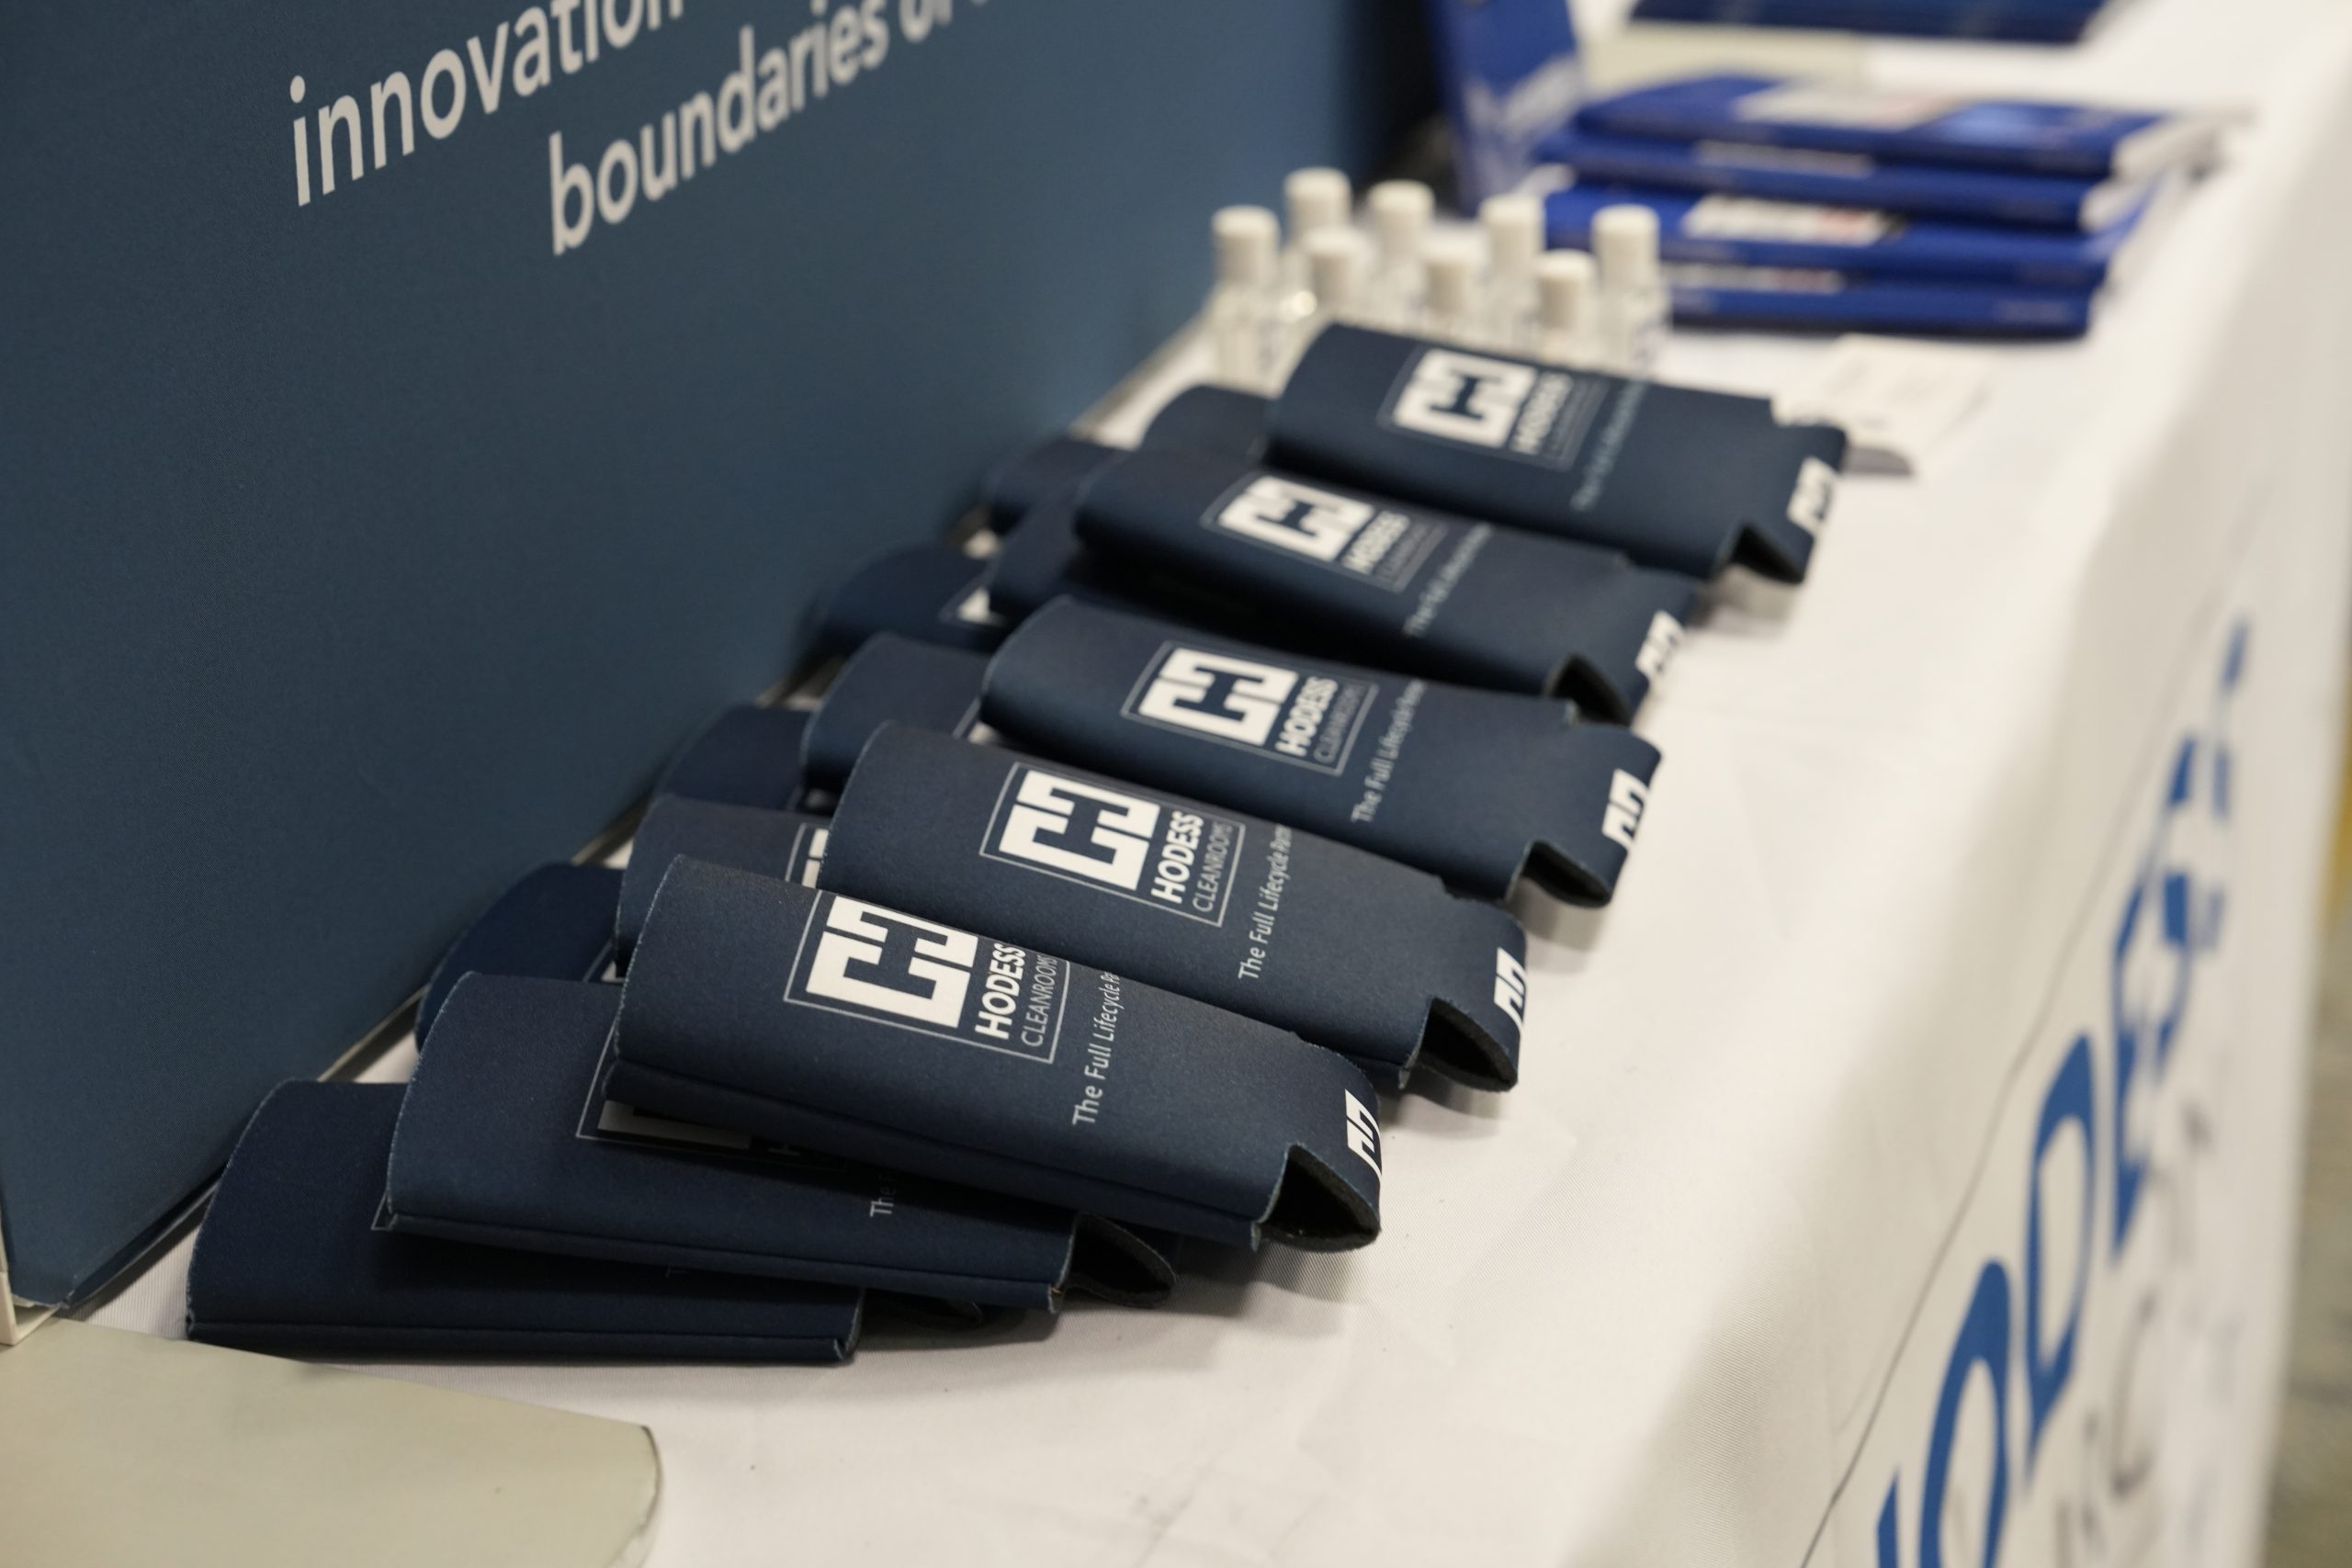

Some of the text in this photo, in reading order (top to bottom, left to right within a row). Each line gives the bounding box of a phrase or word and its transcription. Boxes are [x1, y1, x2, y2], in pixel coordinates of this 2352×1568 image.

[550, 0, 890, 255] boundaries
[1150, 811, 1204, 905] HODESS
[1257, 853, 1292, 912] Lifecycle
[1249, 911, 1276, 945] Full
[974, 942, 1026, 1040] HODESS
[1238, 946, 1266, 980] The
[1021, 954, 1057, 1047] CLEANROOMS
[1092, 983, 1125, 1042] Lifecycle
[1084, 1043, 1113, 1080] Full
[1071, 1085, 1103, 1125] The
